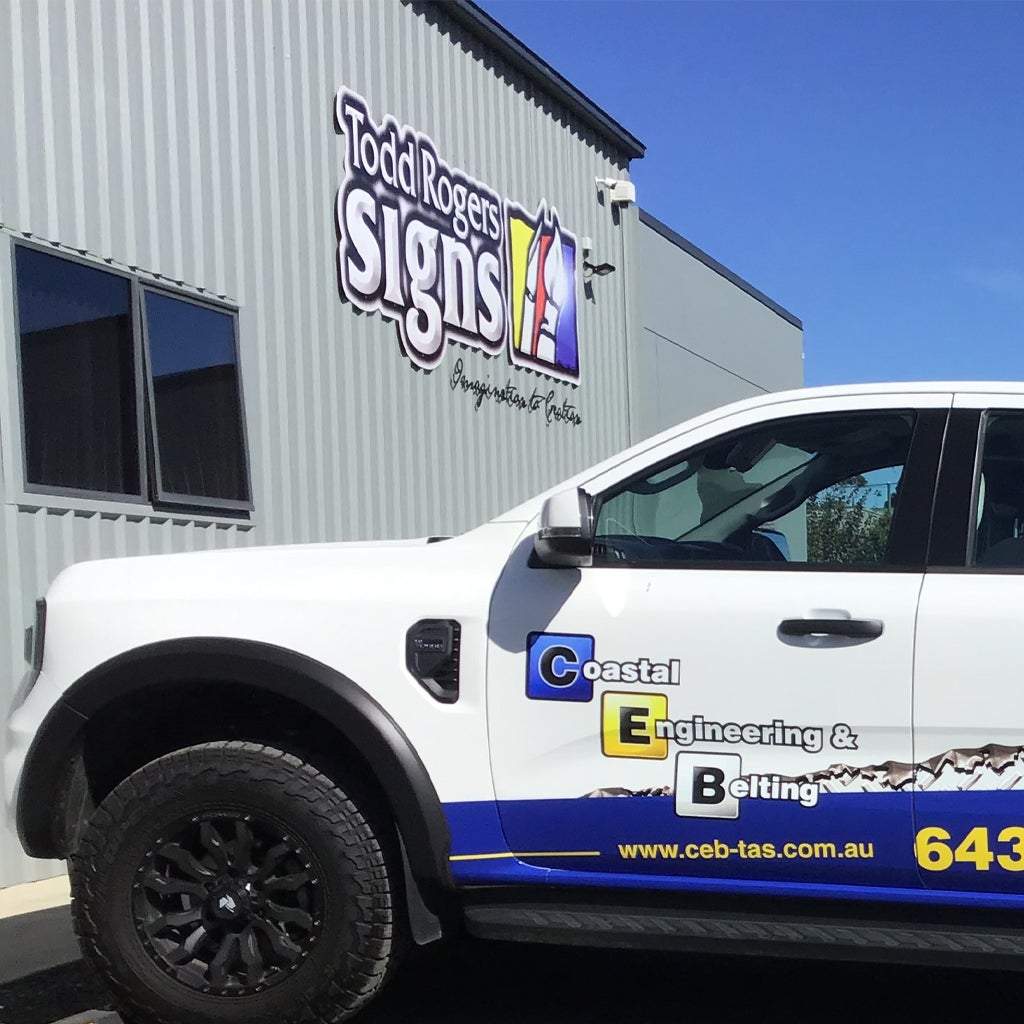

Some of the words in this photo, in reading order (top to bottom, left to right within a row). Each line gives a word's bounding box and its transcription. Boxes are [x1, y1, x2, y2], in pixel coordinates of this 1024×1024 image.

[345, 104, 416, 197] Todd
[421, 148, 500, 240] Rogers
[346, 188, 500, 354] Signs
[538, 644, 681, 688] Coastal
[619, 705, 823, 751] Engineering
[830, 723, 858, 750] &
[692, 766, 820, 808] Belting
[618, 839, 875, 860] www.ceb-tas.com.au
